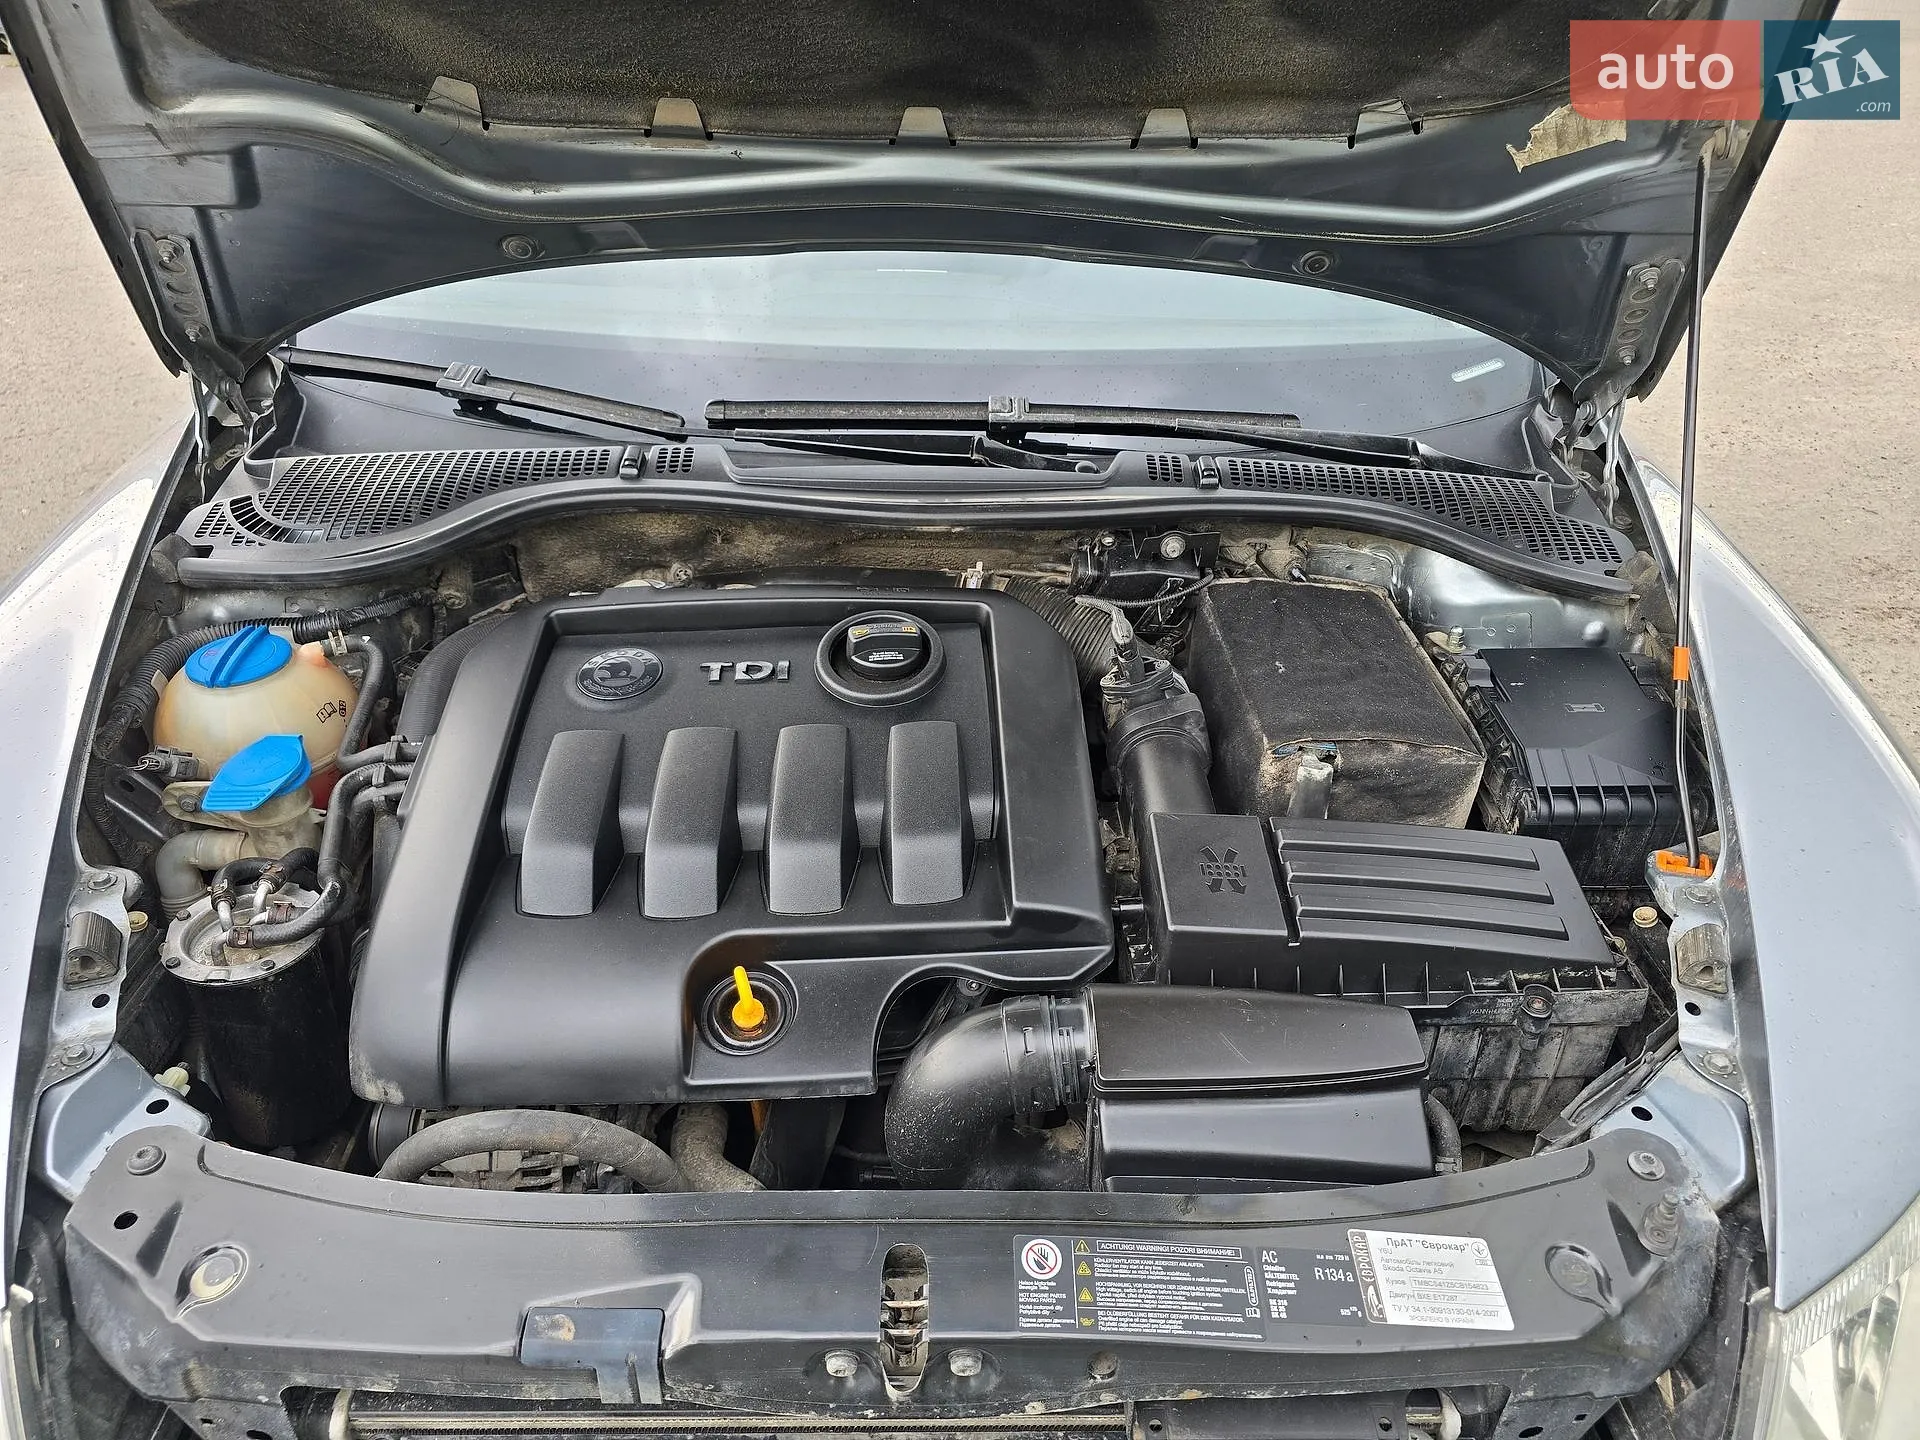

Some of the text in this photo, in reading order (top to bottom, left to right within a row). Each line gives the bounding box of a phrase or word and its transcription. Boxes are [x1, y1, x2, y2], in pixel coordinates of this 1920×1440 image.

[700, 660, 790, 683] TDI
[1100, 1243, 1135, 1251] ACHTUNG!
[1136, 1244, 1170, 1252] WARNING!
[1170, 1246, 1196, 1254] POZOR!
[1386, 1237, 1470, 1253] ПрАТ "Єврокар"
[1262, 1250, 1278, 1263] AC
[1353, 1235, 1375, 1282] ЄВРОКАР
[1314, 1267, 1355, 1282] R 134 a
